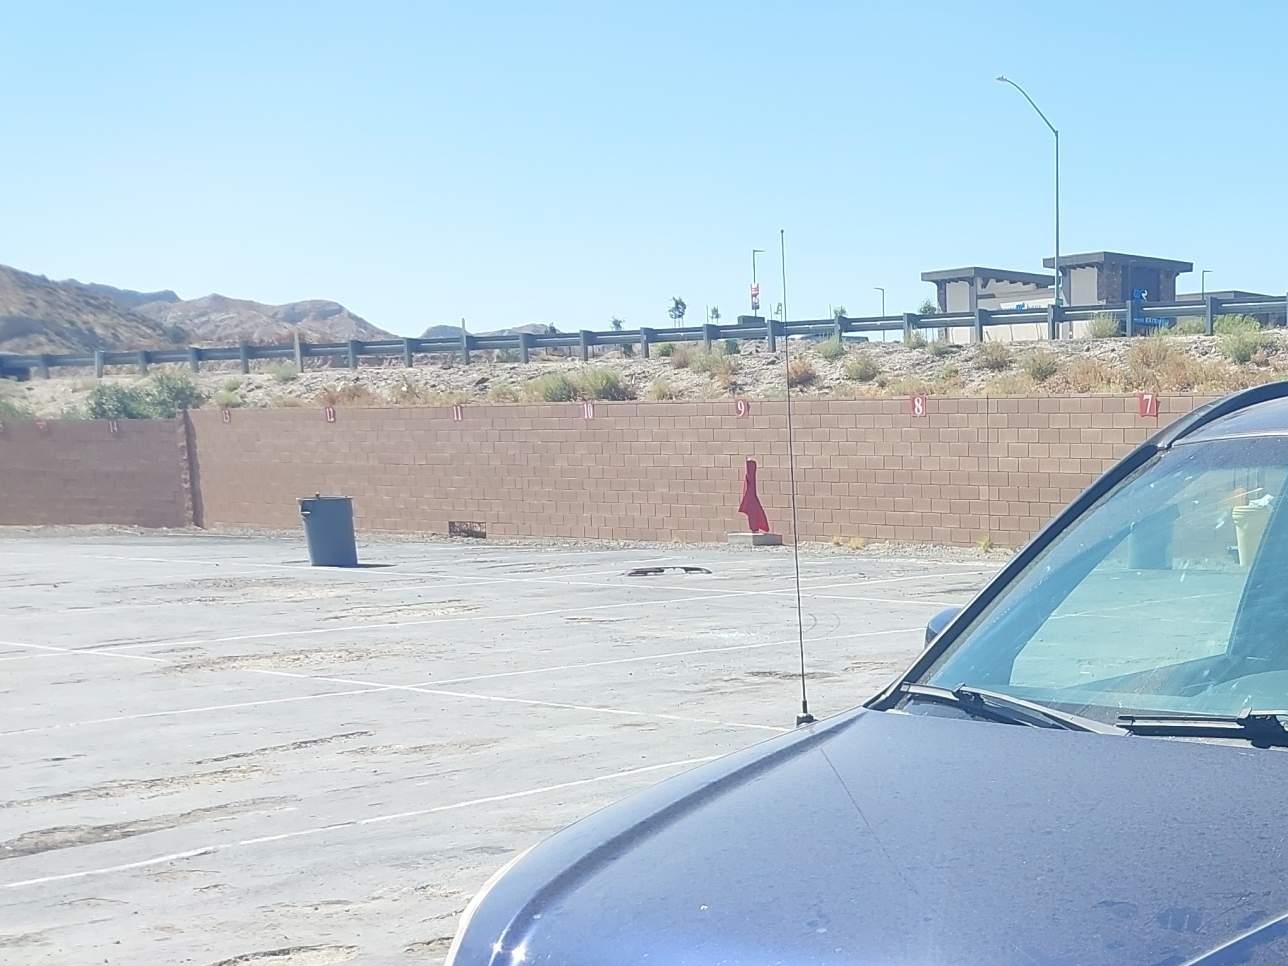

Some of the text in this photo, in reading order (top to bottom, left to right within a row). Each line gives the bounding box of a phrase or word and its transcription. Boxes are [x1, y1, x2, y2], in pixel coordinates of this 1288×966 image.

[453, 405, 462, 421] 11
[583, 402, 593, 419] 10
[737, 400, 745, 417] 9
[914, 397, 923, 415] 8
[1143, 394, 1153, 415] 7
